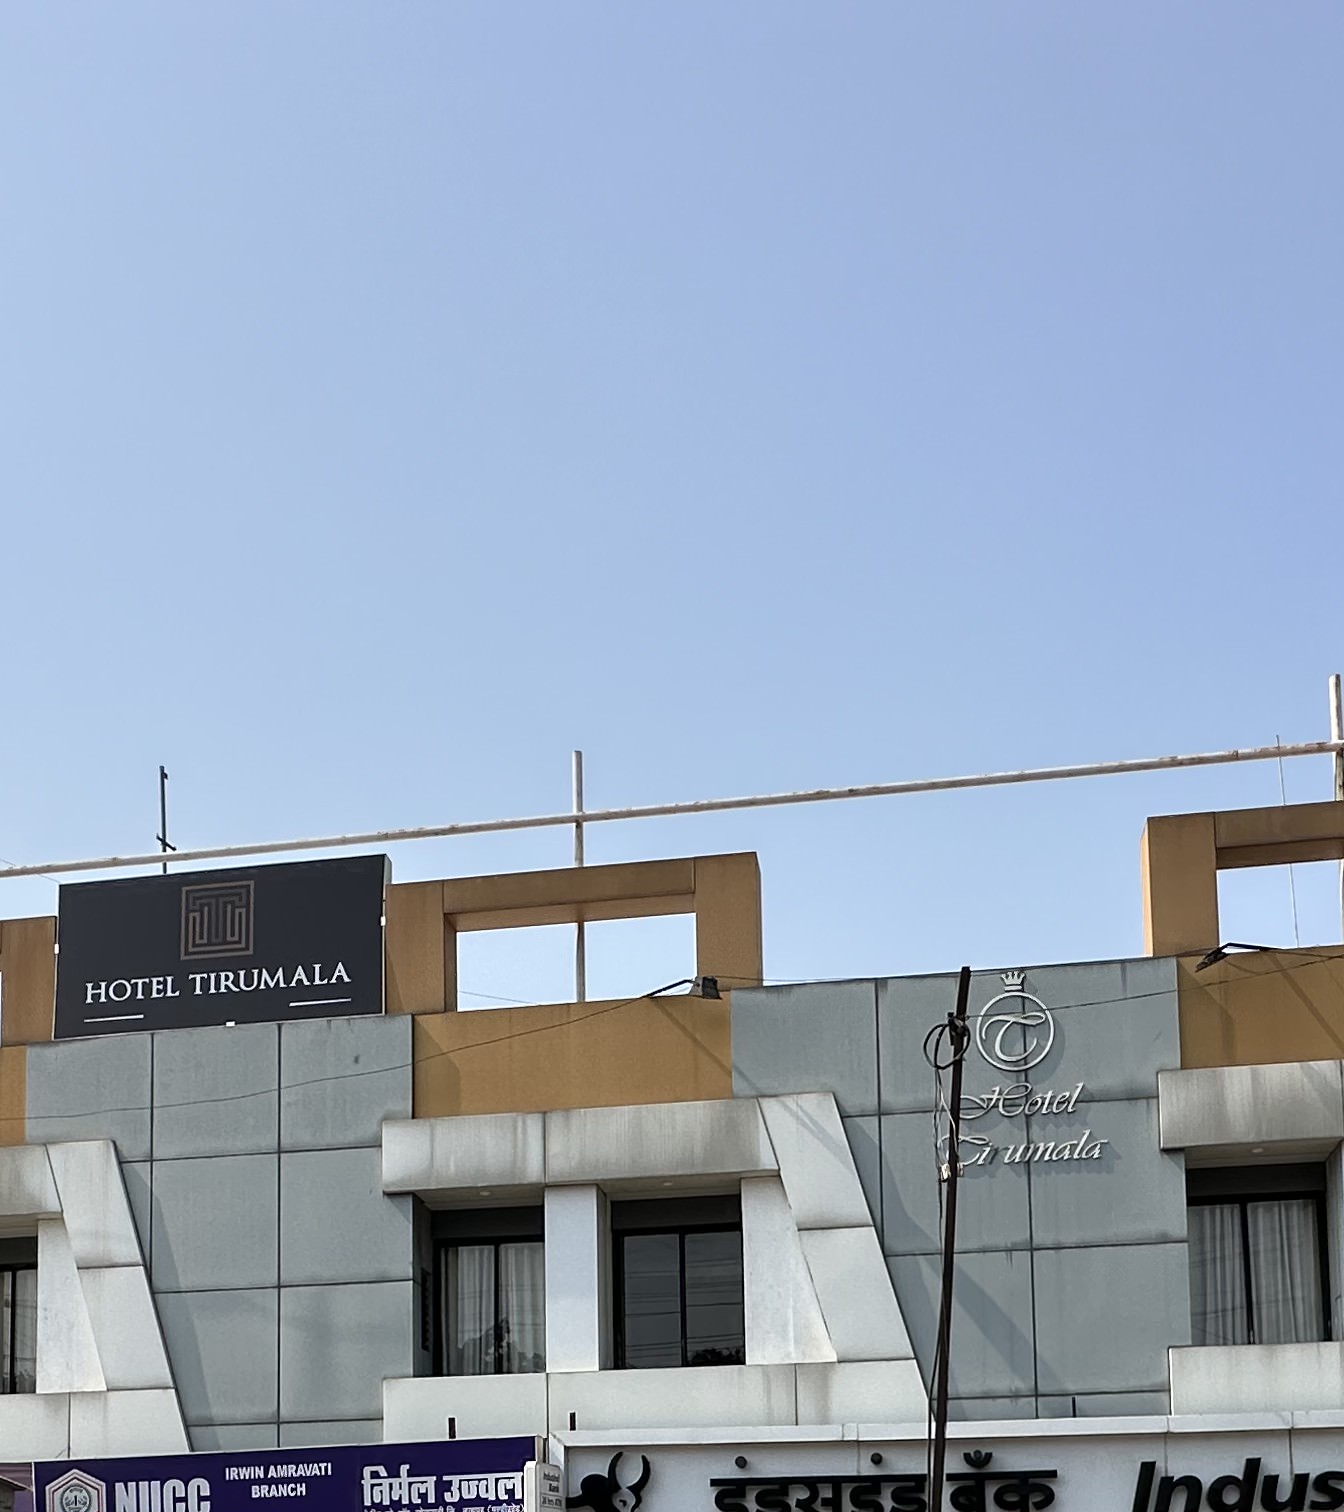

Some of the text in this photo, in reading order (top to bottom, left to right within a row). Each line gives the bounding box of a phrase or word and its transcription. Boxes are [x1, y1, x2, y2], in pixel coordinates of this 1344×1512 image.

[85, 962, 352, 1003] HOTEL TIRUMALA
[959, 1081, 1085, 1120] Hotel
[225, 1462, 332, 1481] IRWIN AMRAVATI
[251, 1482, 306, 1499] BRANCH
[361, 1464, 436, 1506] निर्मल
